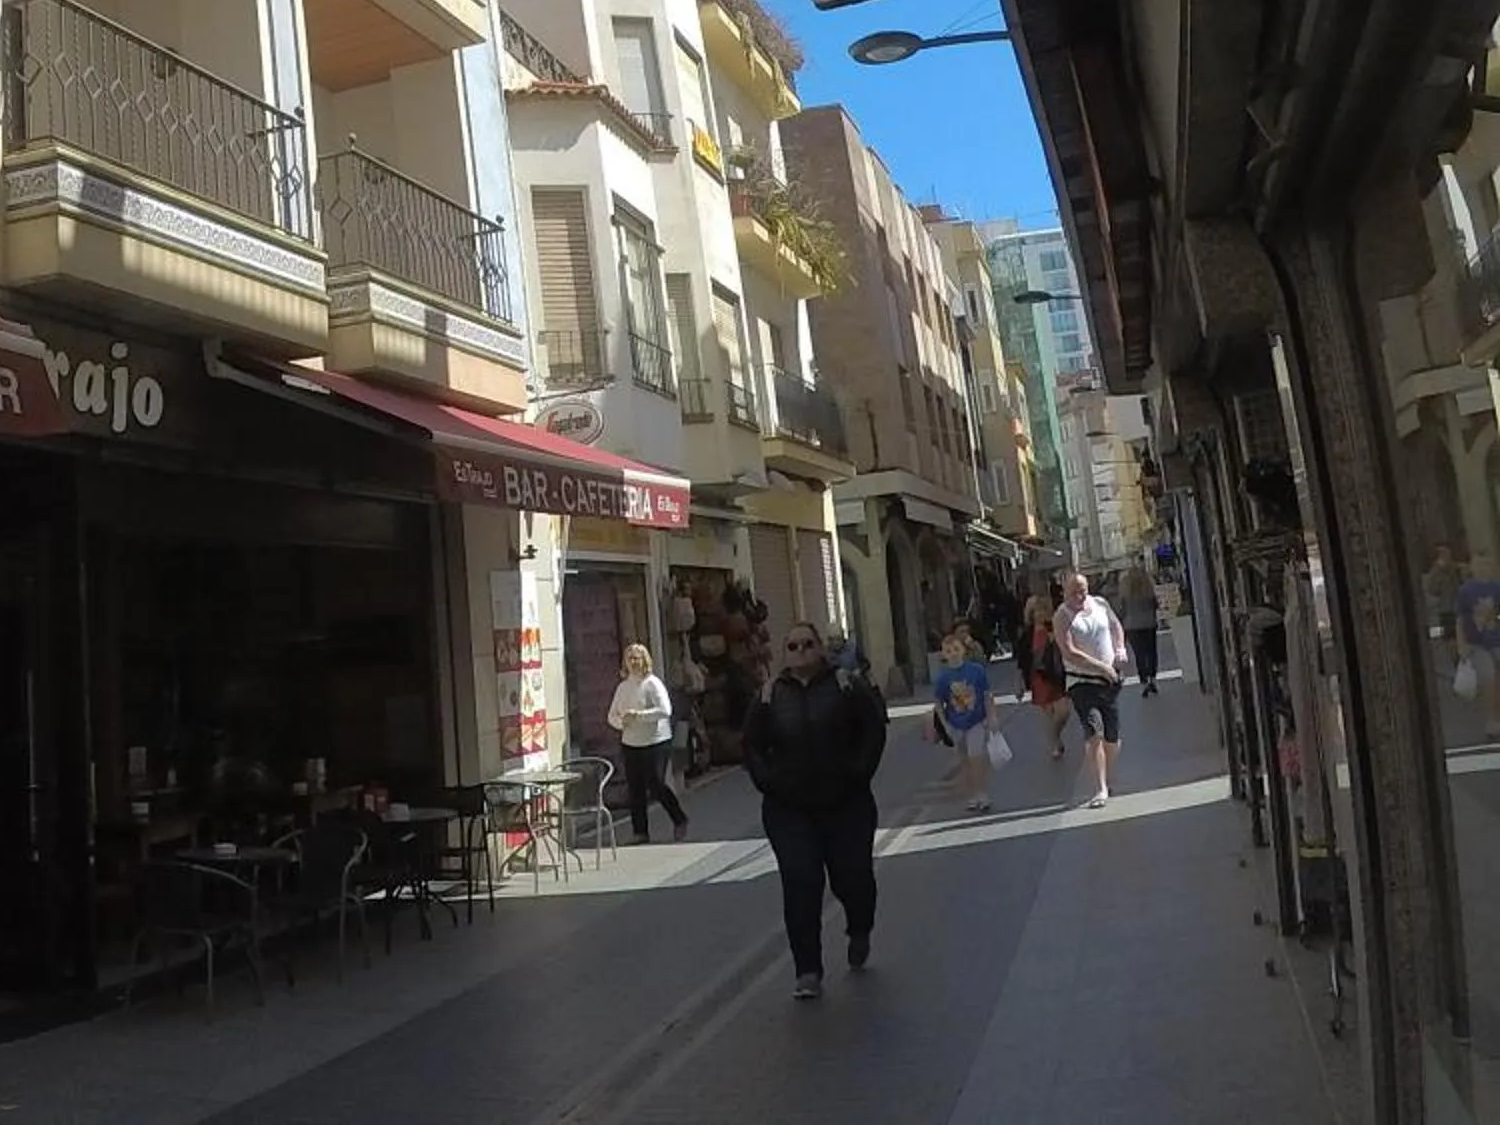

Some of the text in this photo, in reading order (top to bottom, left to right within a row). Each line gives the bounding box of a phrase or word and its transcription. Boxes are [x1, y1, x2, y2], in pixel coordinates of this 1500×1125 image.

[43, 341, 164, 433] rajo
[503, 466, 550, 508] BAR
[561, 475, 654, 521] CAFETERIA
